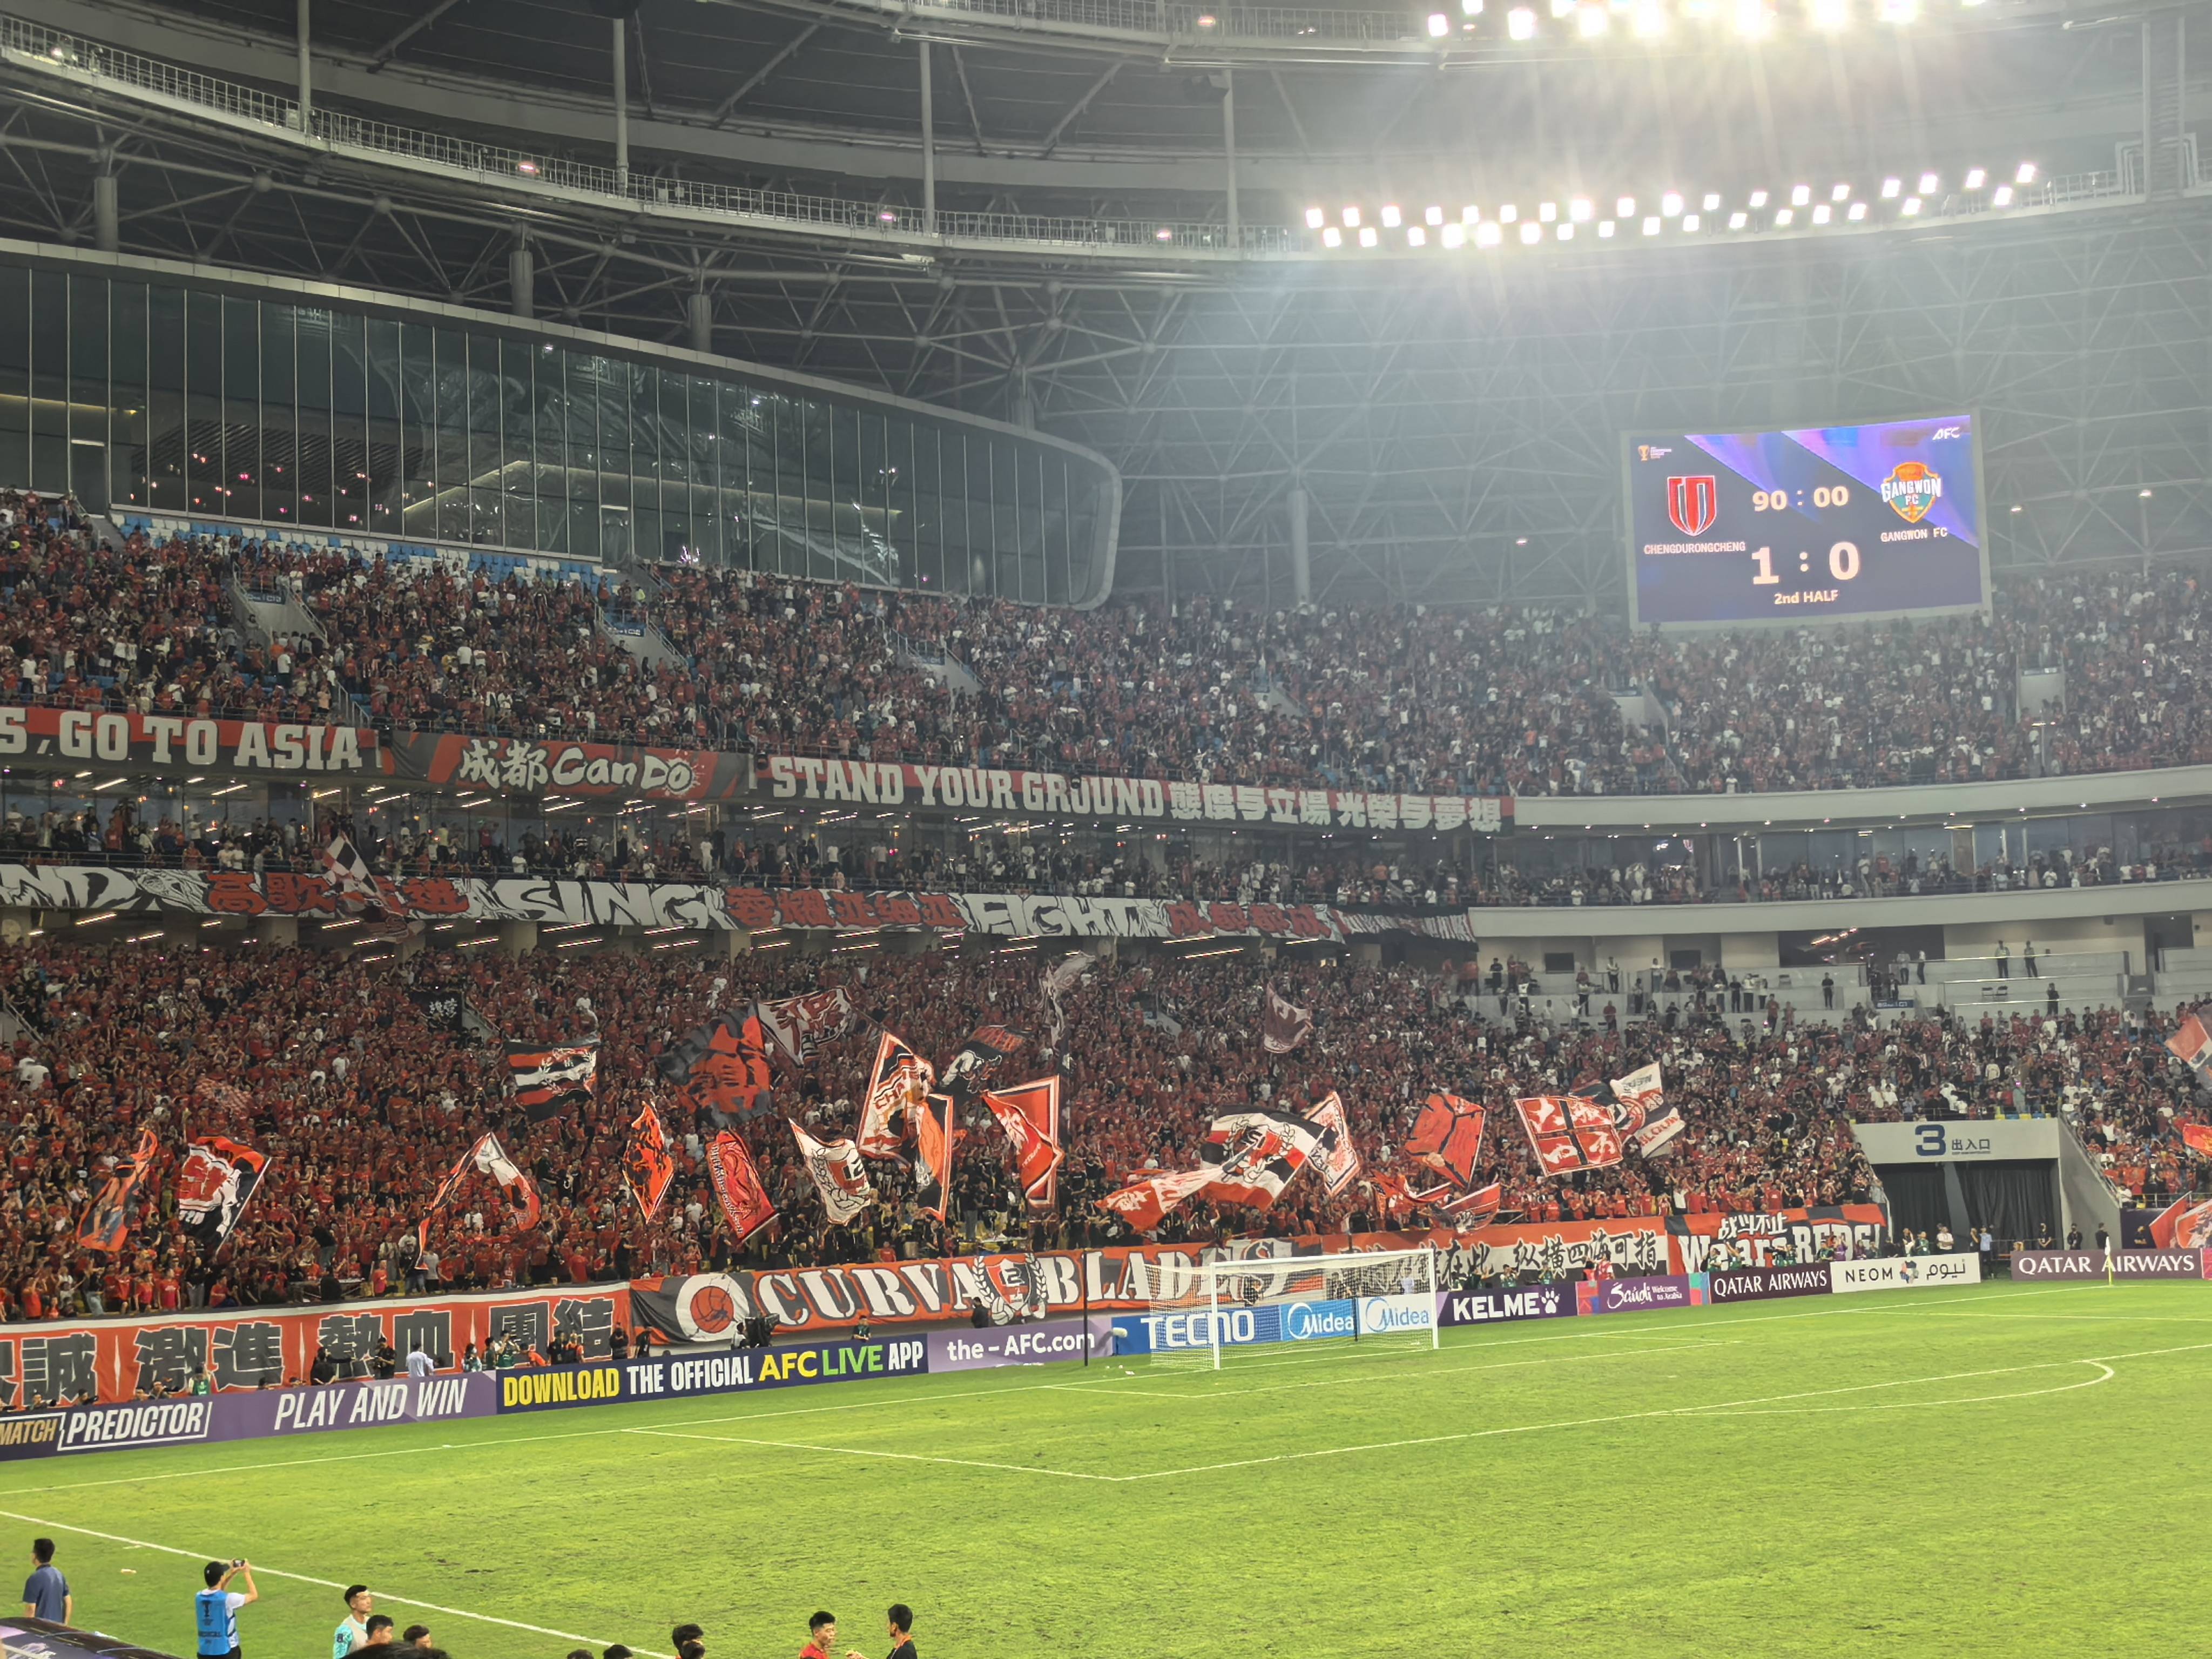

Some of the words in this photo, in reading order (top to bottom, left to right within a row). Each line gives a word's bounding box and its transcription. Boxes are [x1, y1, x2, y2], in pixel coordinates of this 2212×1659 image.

[1752, 490, 1787, 511] 90
[1813, 486, 1849, 508] 00
[1880, 478, 1941, 502] GANGWON
[1644, 541, 1746, 555] CHENGDURONGCHENG
[1880, 530, 1928, 541] GANGWON
[1933, 528, 1948, 538] FC
[1751, 547, 1779, 585] 1
[1829, 542, 1860, 581] 0
[1775, 592, 1799, 604] 2nd
[1803, 590, 1838, 603] HALF
[60, 711, 129, 761] GO
[143, 716, 217, 765] TO
[234, 722, 362, 770] ASIA
[459, 739, 547, 791] 成都
[552, 747, 635, 786] Can
[771, 758, 904, 805] STAND
[916, 766, 1016, 810] YOUR
[1022, 772, 1163, 817] GROUND
[492, 879, 724, 929] SING
[963, 893, 1138, 938] FIGHT
[1915, 1124, 1946, 1156] 3
[1951, 1139, 1990, 1151] 出入口
[1718, 1212, 1788, 1240] 战斗不止
[1845, 1267, 1892, 1282] NEOM
[1926, 1258, 1966, 1279] نيوم
[2019, 1257, 2091, 1274] QATAR
[2102, 1255, 2194, 1273] AIRWAYS
[758, 1262, 990, 1326] CURVA
[1036, 1239, 1292, 1304] BLADES
[1607, 1282, 1653, 1309] Saudi
[1651, 1285, 1678, 1293] Welcome
[1714, 1274, 1763, 1297] QATAR
[1769, 1269, 1827, 1290] AIRWAYS
[1381, 1306, 1429, 1326] Midea
[1453, 1292, 1540, 1321] KELME
[1141, 1309, 1255, 1350] TECNO
[1303, 1310, 1354, 1332] Midea
[317, 1309, 455, 1380] 熱血
[948, 1339, 986, 1361] the
[1003, 1331, 1095, 1356] AFC.com
[503, 1368, 620, 1407] DOWNLOAD
[626, 1363, 664, 1395] THE
[671, 1356, 753, 1391] OFFICIAL
[759, 1351, 818, 1382] AFC
[822, 1345, 883, 1377] LIVE
[888, 1341, 923, 1371] APP
[274, 1389, 346, 1431] PLAY
[349, 1384, 408, 1424] AND
[416, 1378, 468, 1416] WIN
[0, 1418, 58, 1445] MATCH
[66, 1402, 202, 1444] PREDICTOR
